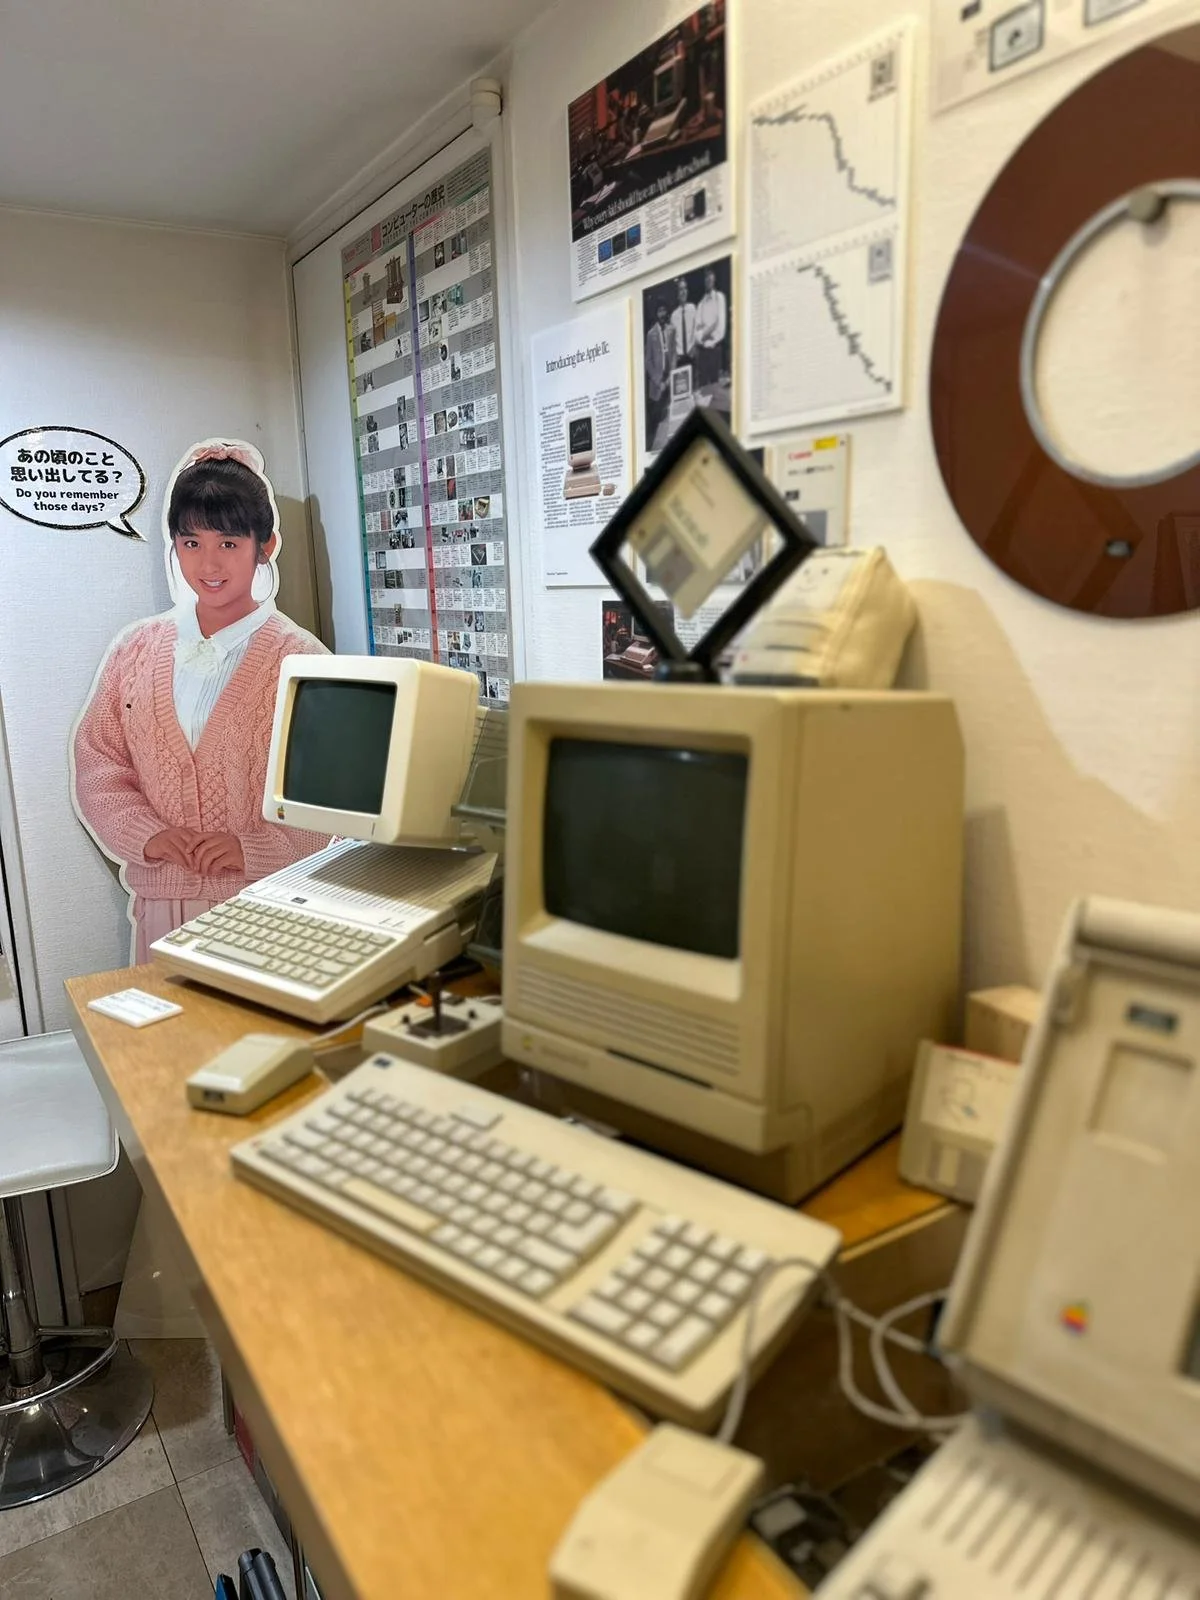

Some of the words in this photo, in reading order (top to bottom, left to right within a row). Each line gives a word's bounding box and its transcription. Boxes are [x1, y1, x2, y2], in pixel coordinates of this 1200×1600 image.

[382, 185, 445, 238] コンピューターの歴史
[545, 353, 576, 373] Introducing
[576, 349, 585, 362] the
[585, 343, 601, 363] Apple
[17, 448, 115, 466] あの頃のこと
[16, 488, 32, 498] Do
[35, 490, 57, 500] you
[60, 489, 119, 500] remember
[33, 502, 68, 511] those
[71, 502, 105, 514] days?
